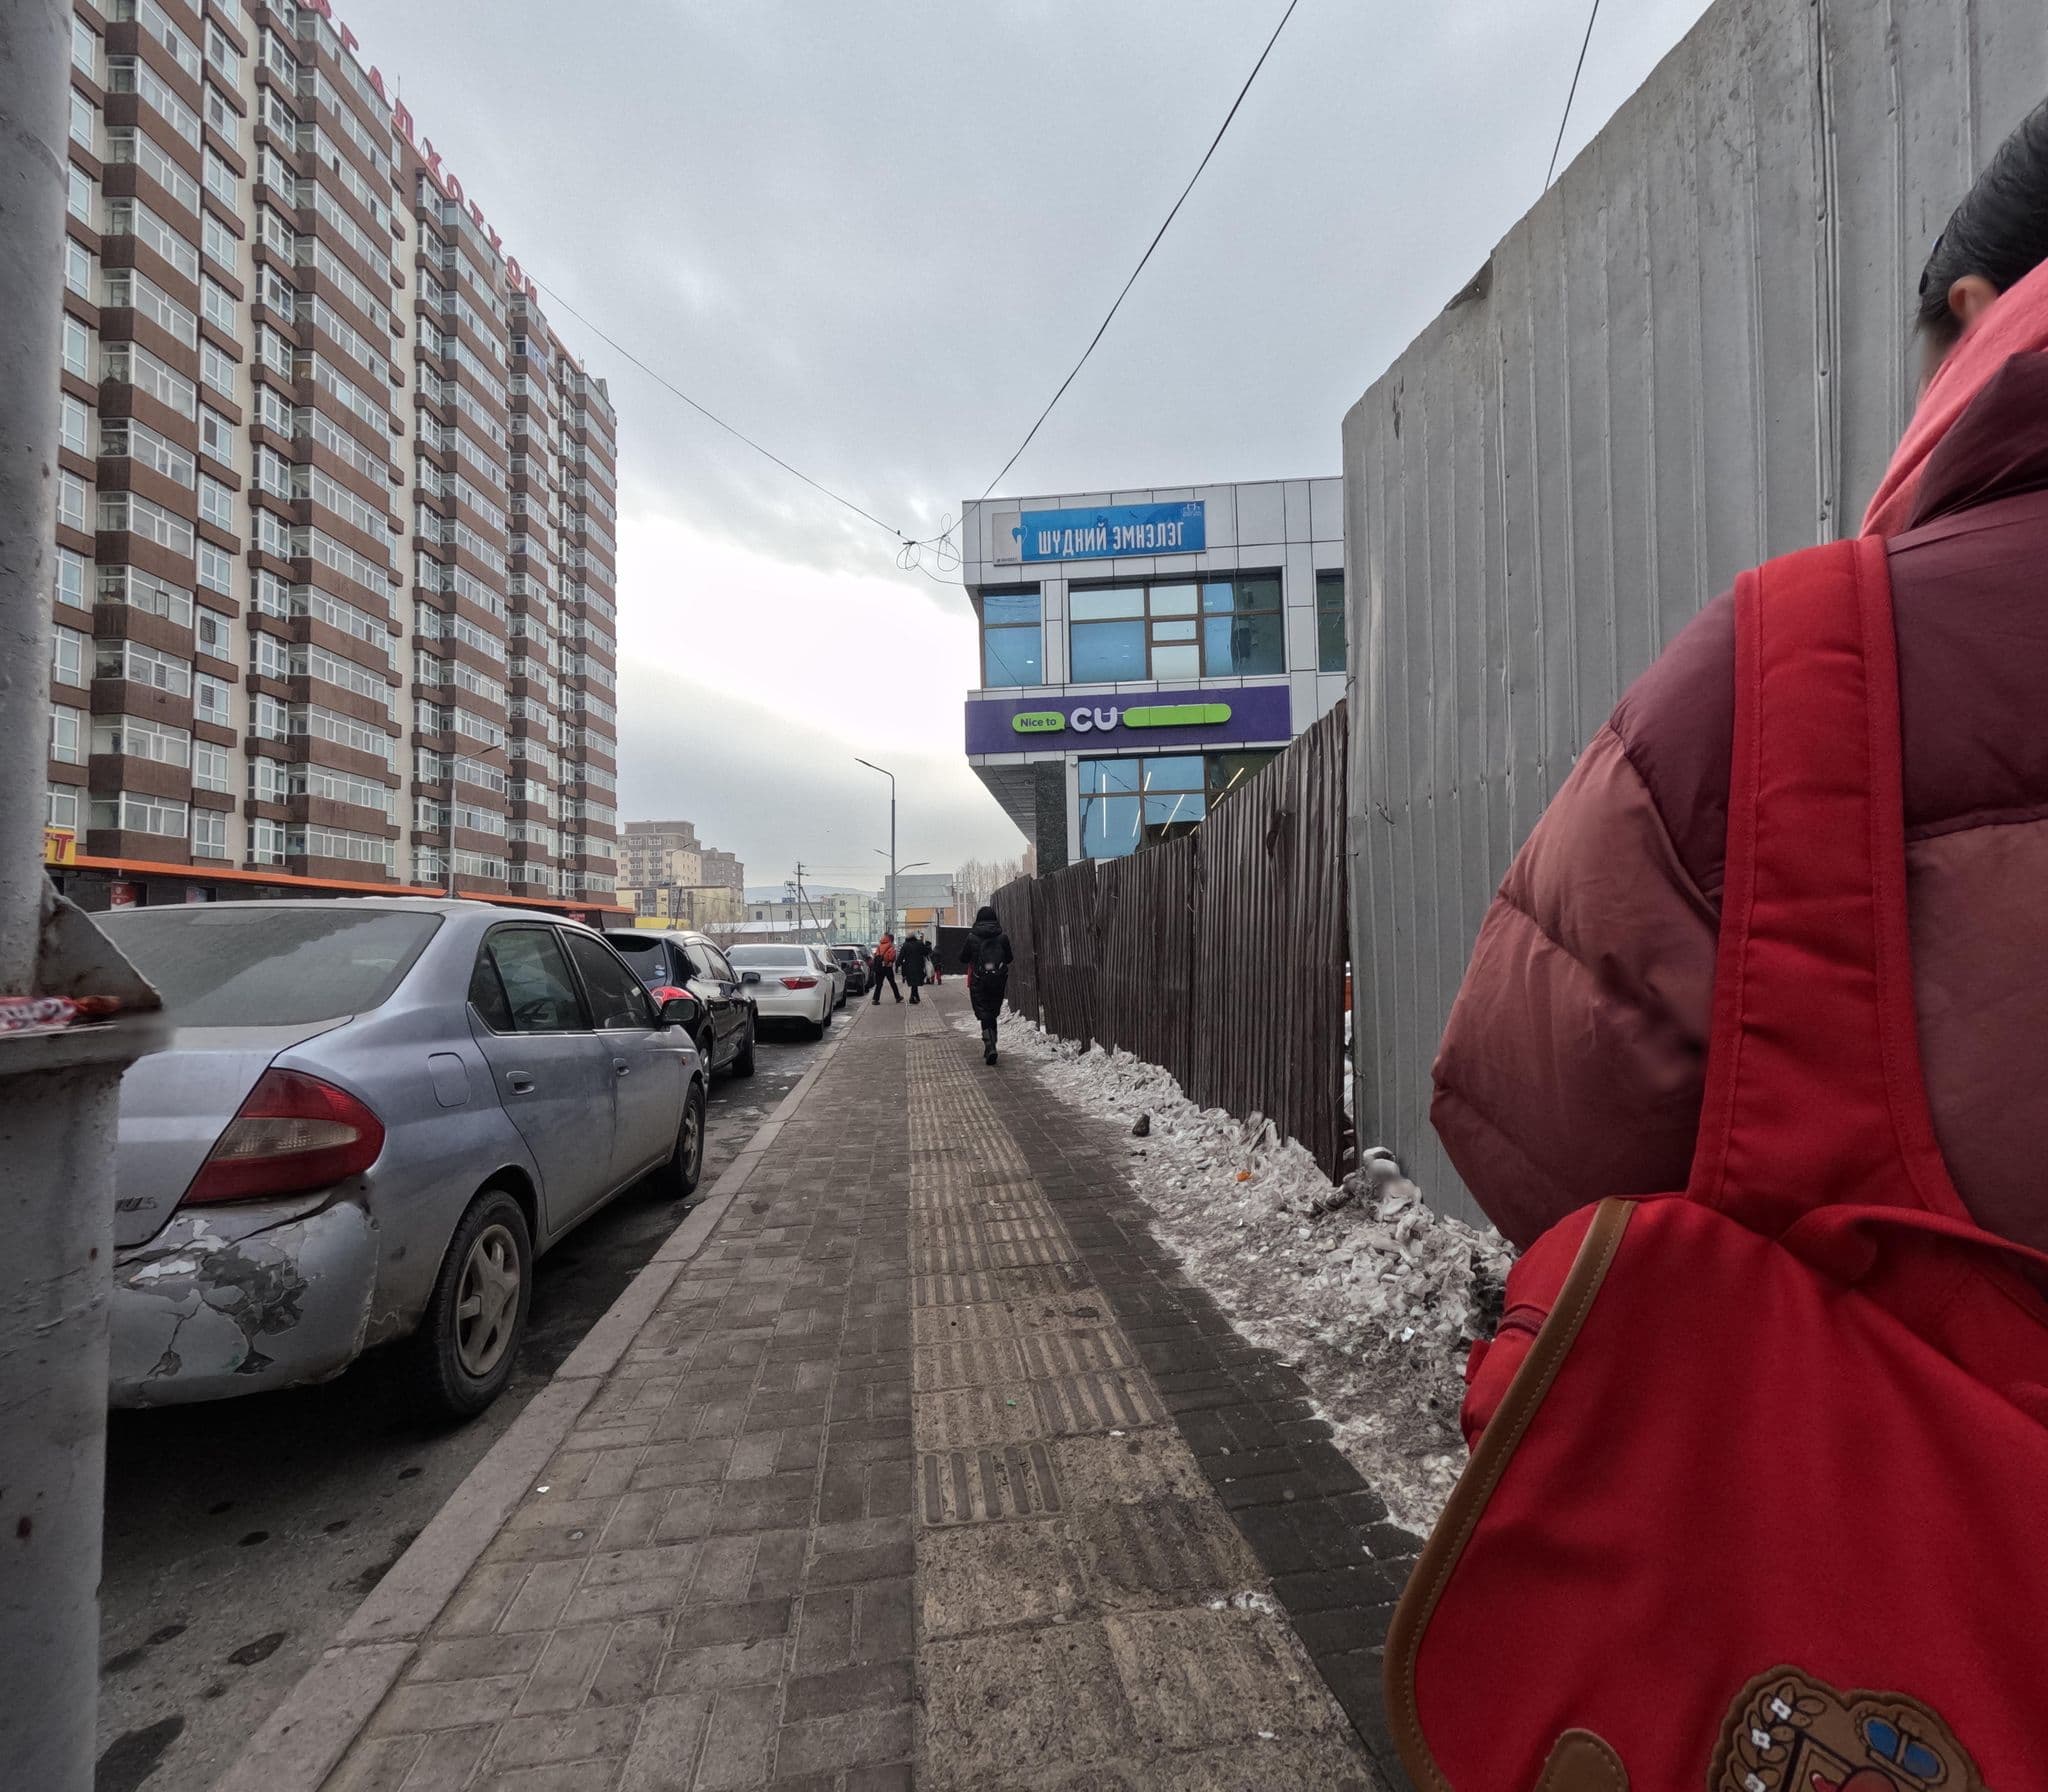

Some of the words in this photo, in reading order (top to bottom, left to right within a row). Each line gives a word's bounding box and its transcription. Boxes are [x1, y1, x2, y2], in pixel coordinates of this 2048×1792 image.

[1038, 523, 1107, 556] ШҮДНИЙ
[1112, 521, 1184, 550] ЭМНЭЛЭГ
[1020, 718, 1044, 727] Nice
[1046, 717, 1057, 726] to
[1070, 706, 1118, 732] CU
